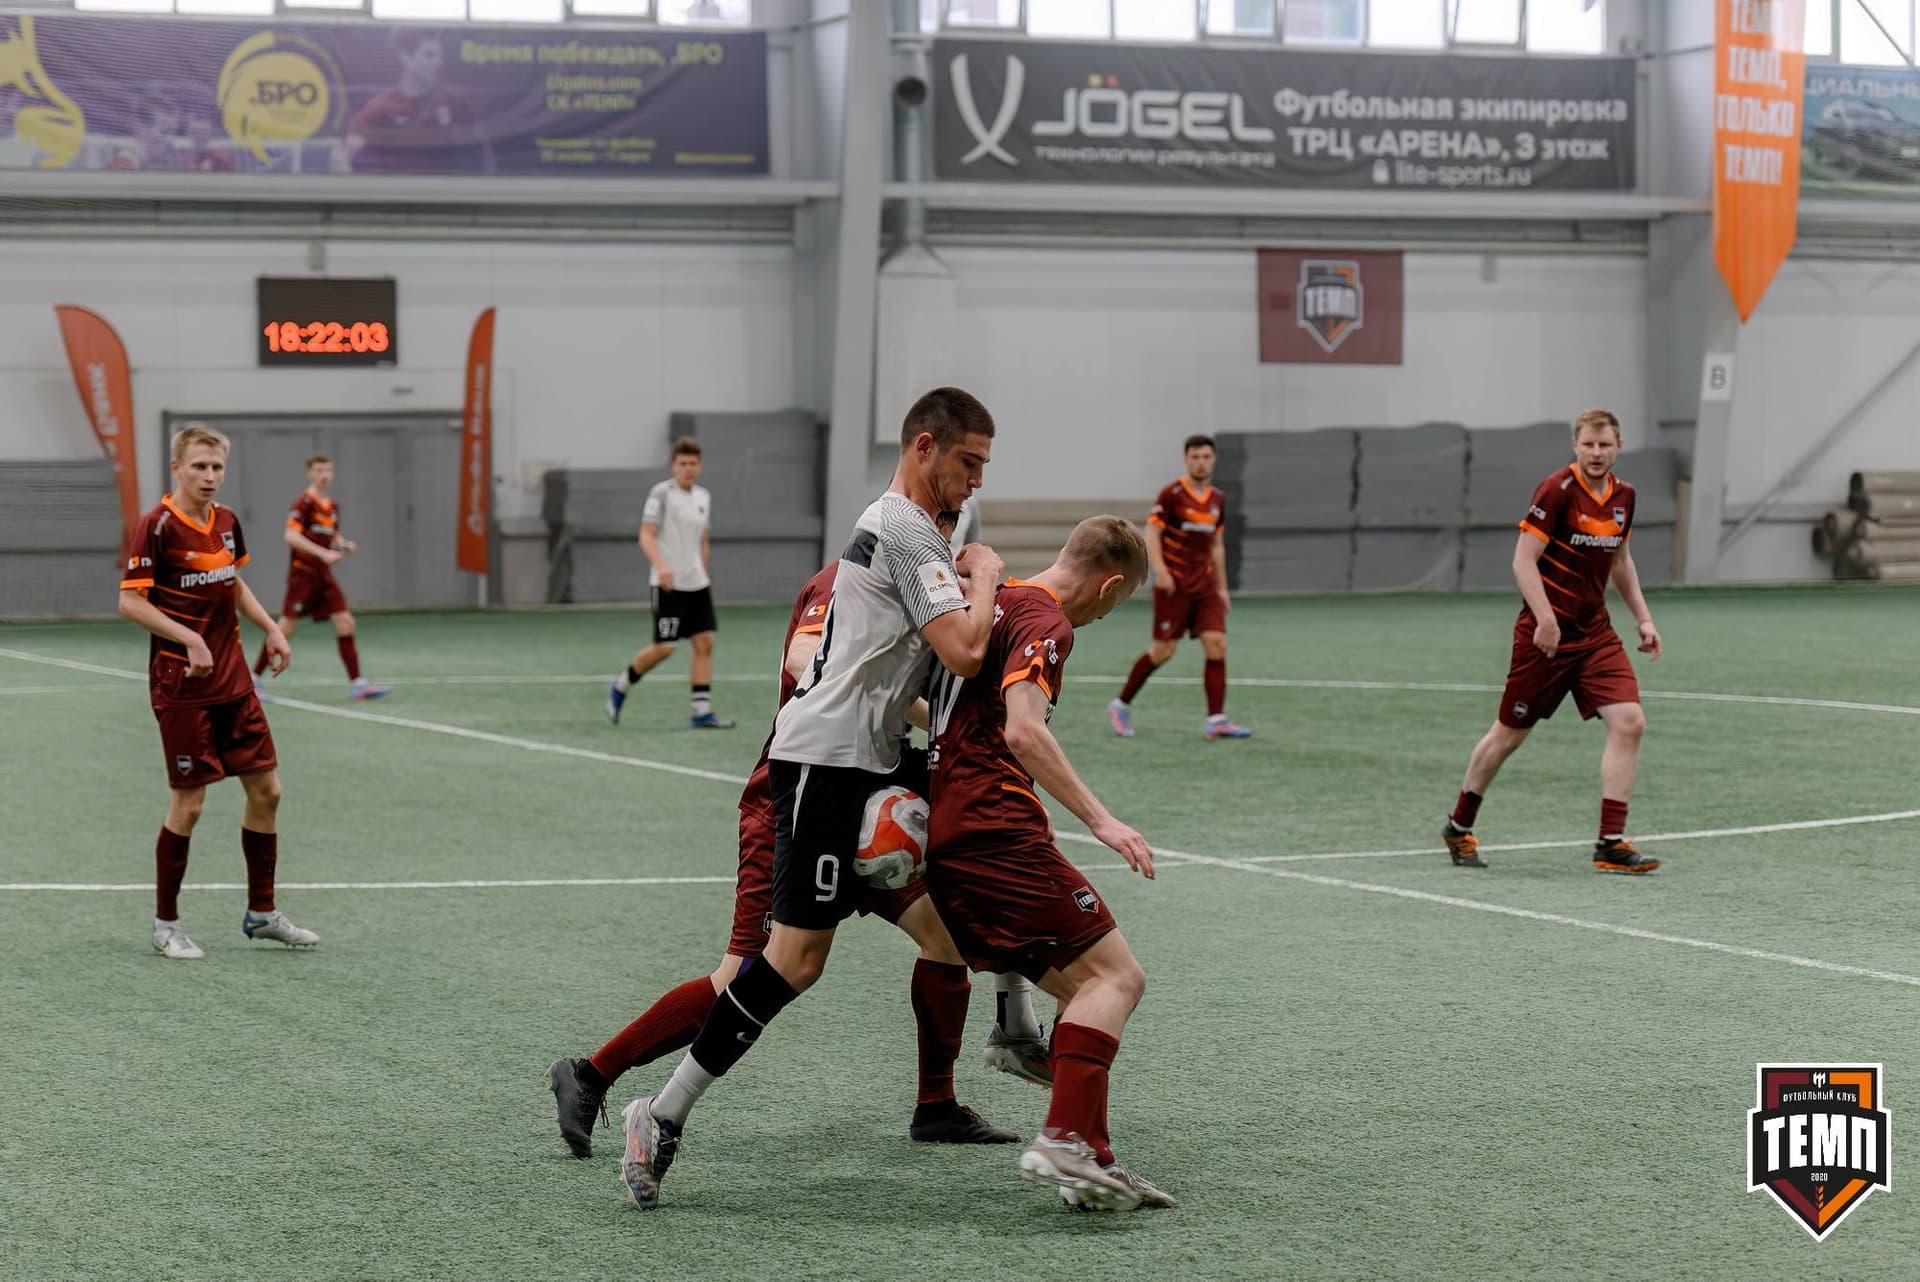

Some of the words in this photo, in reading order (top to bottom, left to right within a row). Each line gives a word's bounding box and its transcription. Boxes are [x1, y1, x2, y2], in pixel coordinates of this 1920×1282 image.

[1031, 73, 1276, 143] JÖGEL
[1273, 88, 1454, 124] Футбольная
[1460, 97, 1628, 127] экипировка
[1287, 127, 1354, 162] ТРЦ
[1358, 128, 1510, 162] «АРЕНА»,
[1515, 132, 1537, 160] 3
[1541, 137, 1608, 160] этаж
[264, 321, 389, 353] 18:22:03
[815, 854, 840, 902] 9
